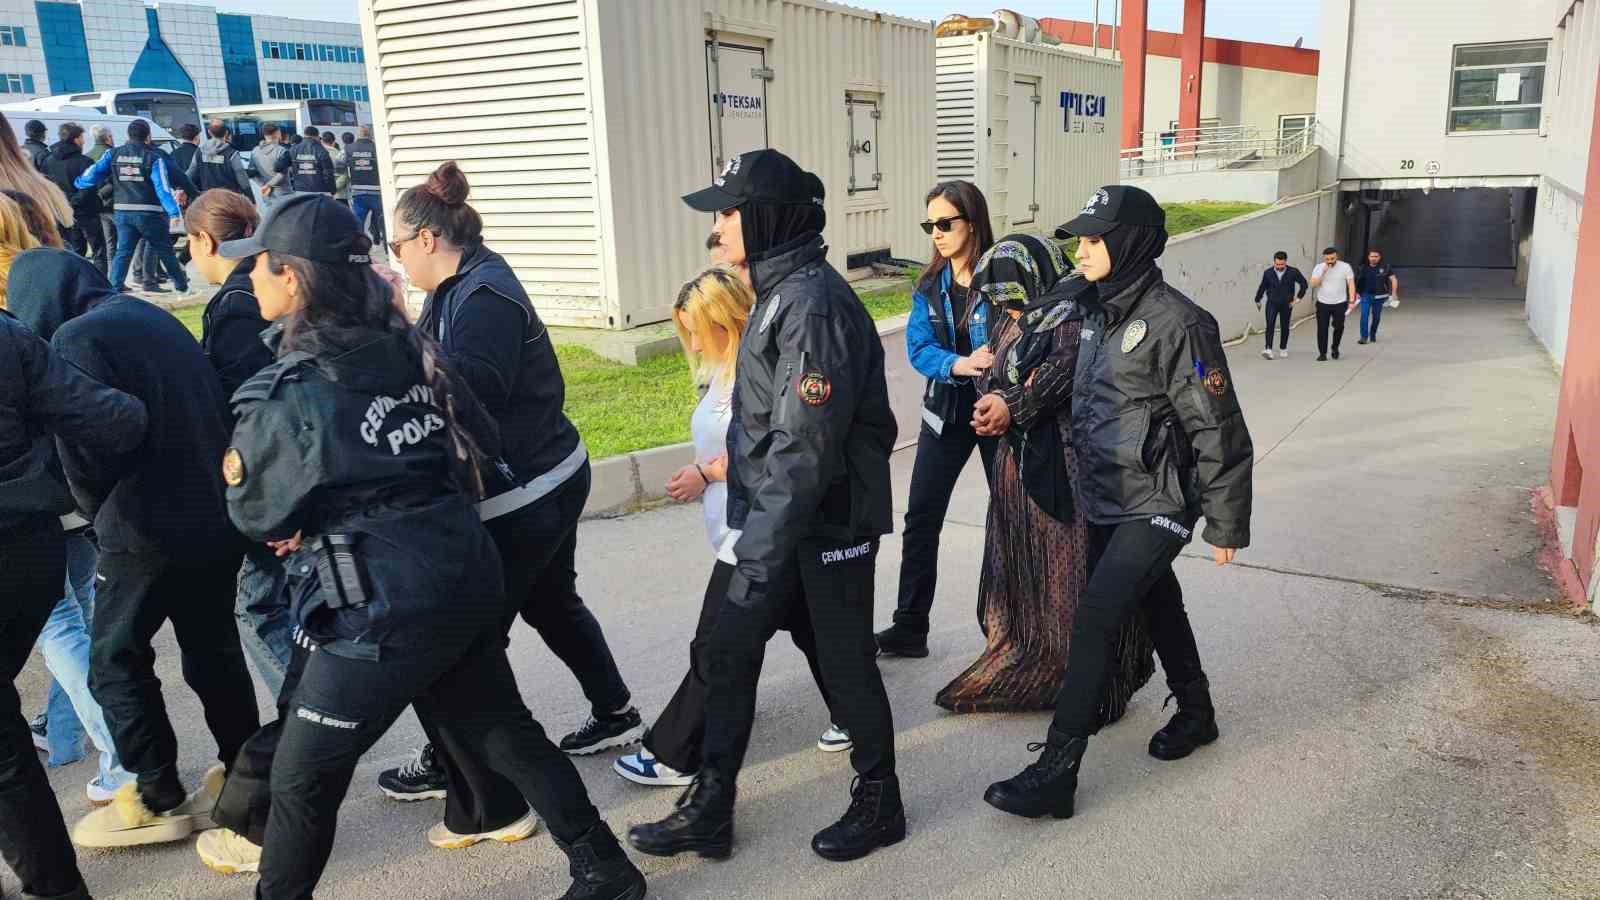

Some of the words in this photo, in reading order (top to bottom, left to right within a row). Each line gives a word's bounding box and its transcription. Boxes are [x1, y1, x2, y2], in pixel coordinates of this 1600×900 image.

[728, 94, 761, 109] TEKSAN
[1400, 160, 1414, 170] 20
[821, 548, 845, 565] ÇEVİK
[844, 541, 871, 560] KUVVET
